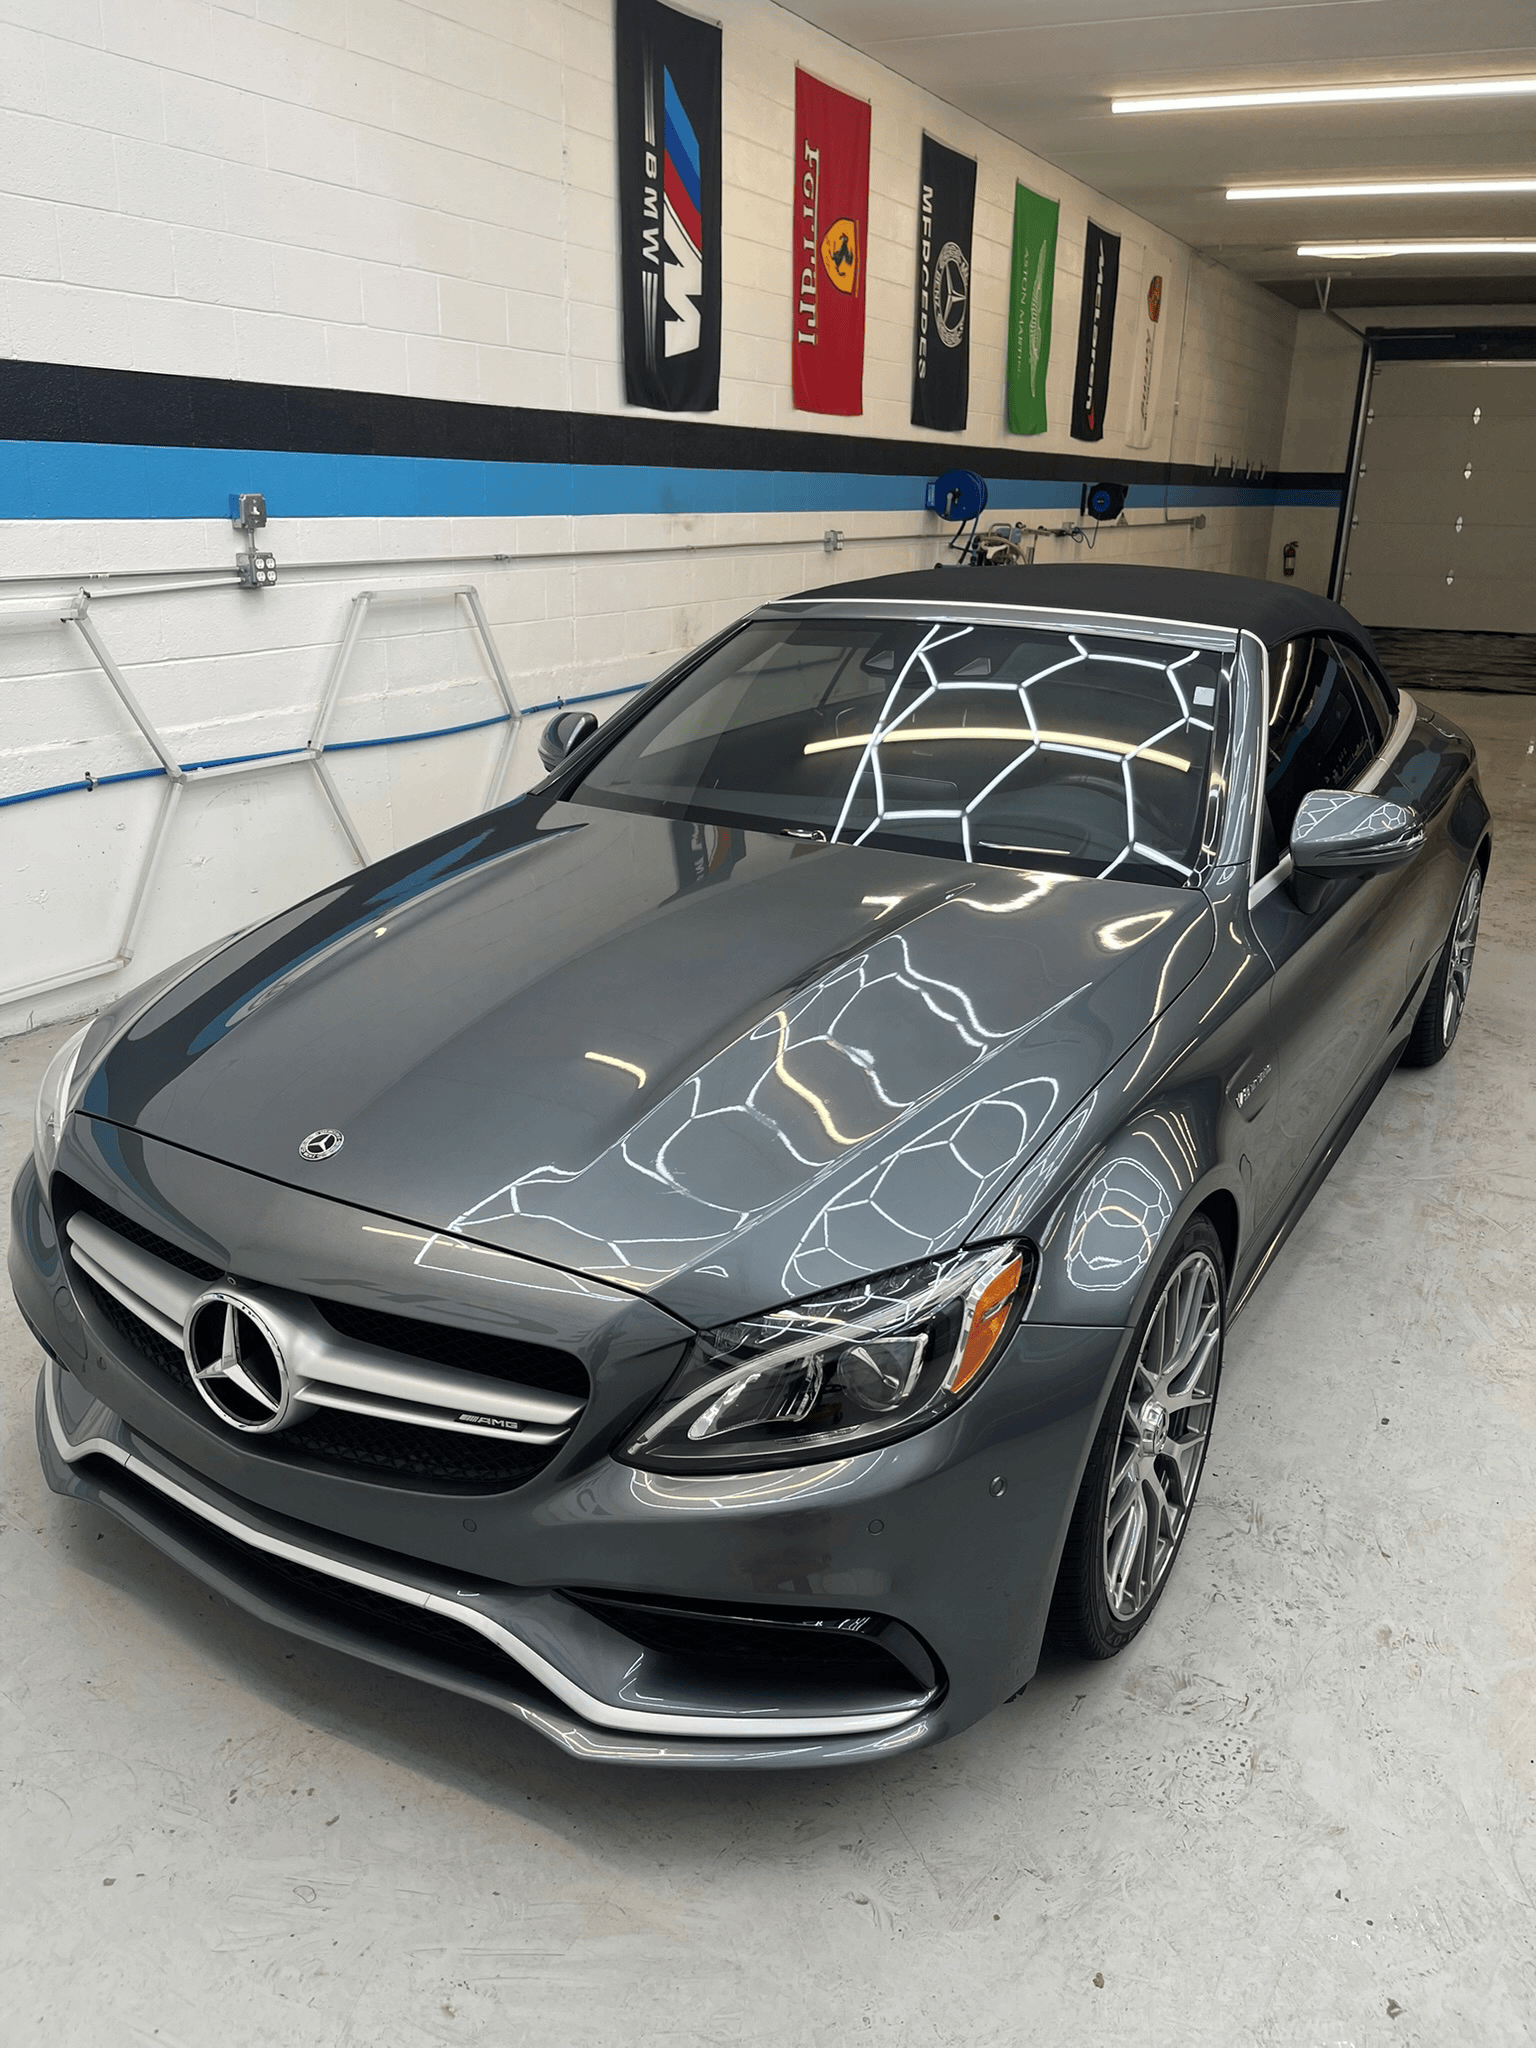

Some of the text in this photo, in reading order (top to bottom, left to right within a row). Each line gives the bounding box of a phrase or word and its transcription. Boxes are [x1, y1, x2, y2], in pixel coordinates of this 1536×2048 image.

[642, 151, 660, 266] BMW
[798, 140, 820, 346] Ferrari
[1020, 247, 1029, 305] ASTON
[663, 202, 703, 359] M
[918, 185, 934, 379] MERCEDES
[477, 1417, 518, 1429] AMG
